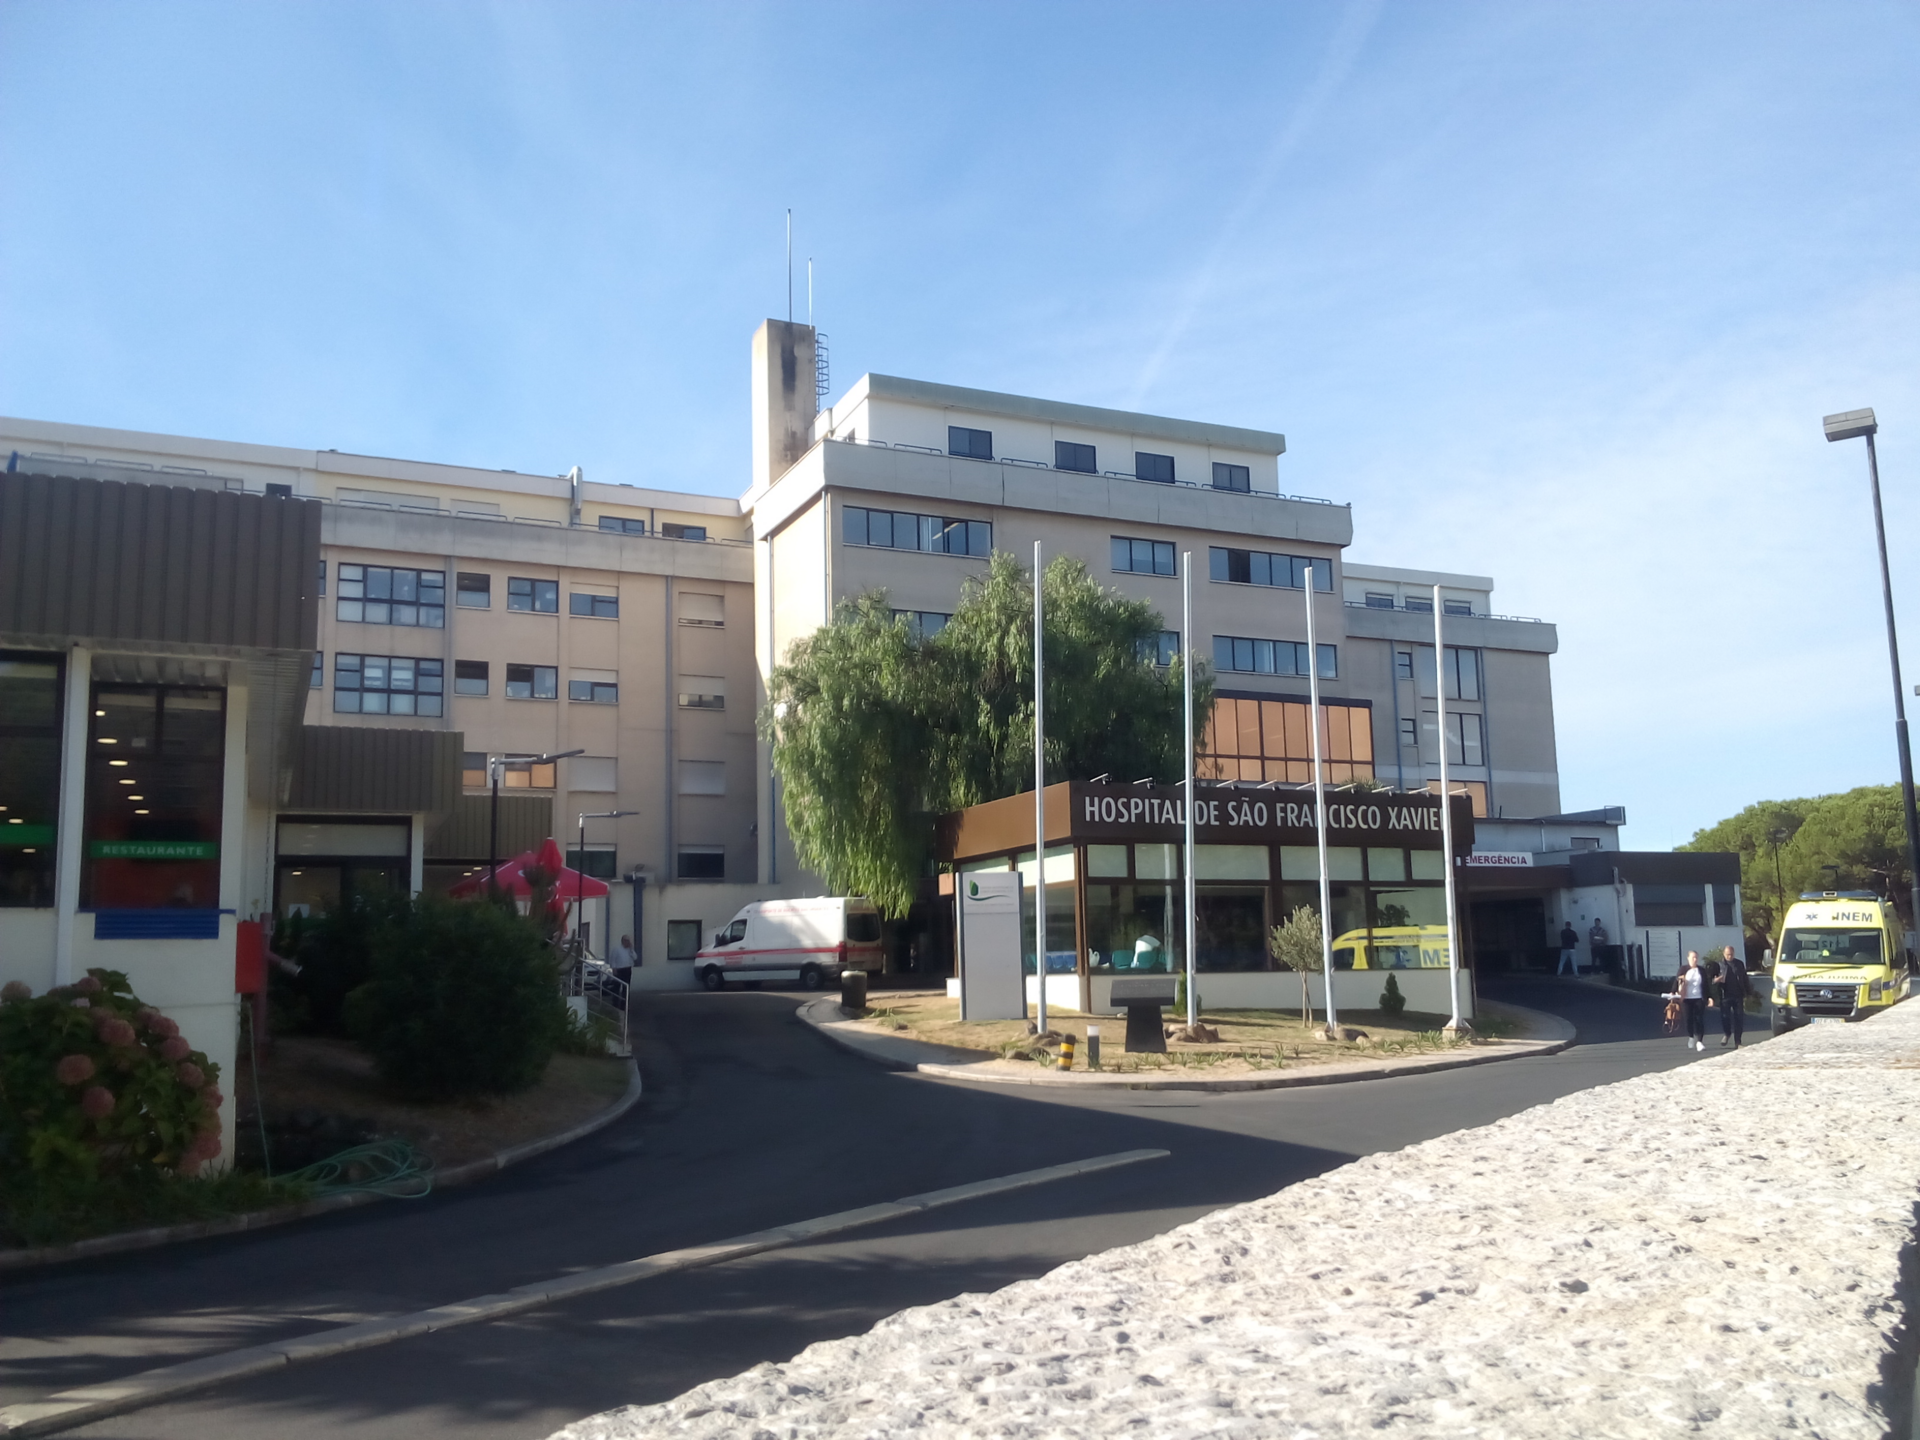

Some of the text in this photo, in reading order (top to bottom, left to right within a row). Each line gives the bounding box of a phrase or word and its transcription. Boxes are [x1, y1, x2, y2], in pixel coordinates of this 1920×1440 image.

[1085, 796, 1186, 825] HOSPITAL
[1194, 800, 1220, 826] DE
[1227, 796, 1268, 826] SÃO
[1387, 806, 1444, 831] XAVIE
[102, 845, 204, 856] RESTAURANTE
[1836, 911, 1873, 923] INEM
